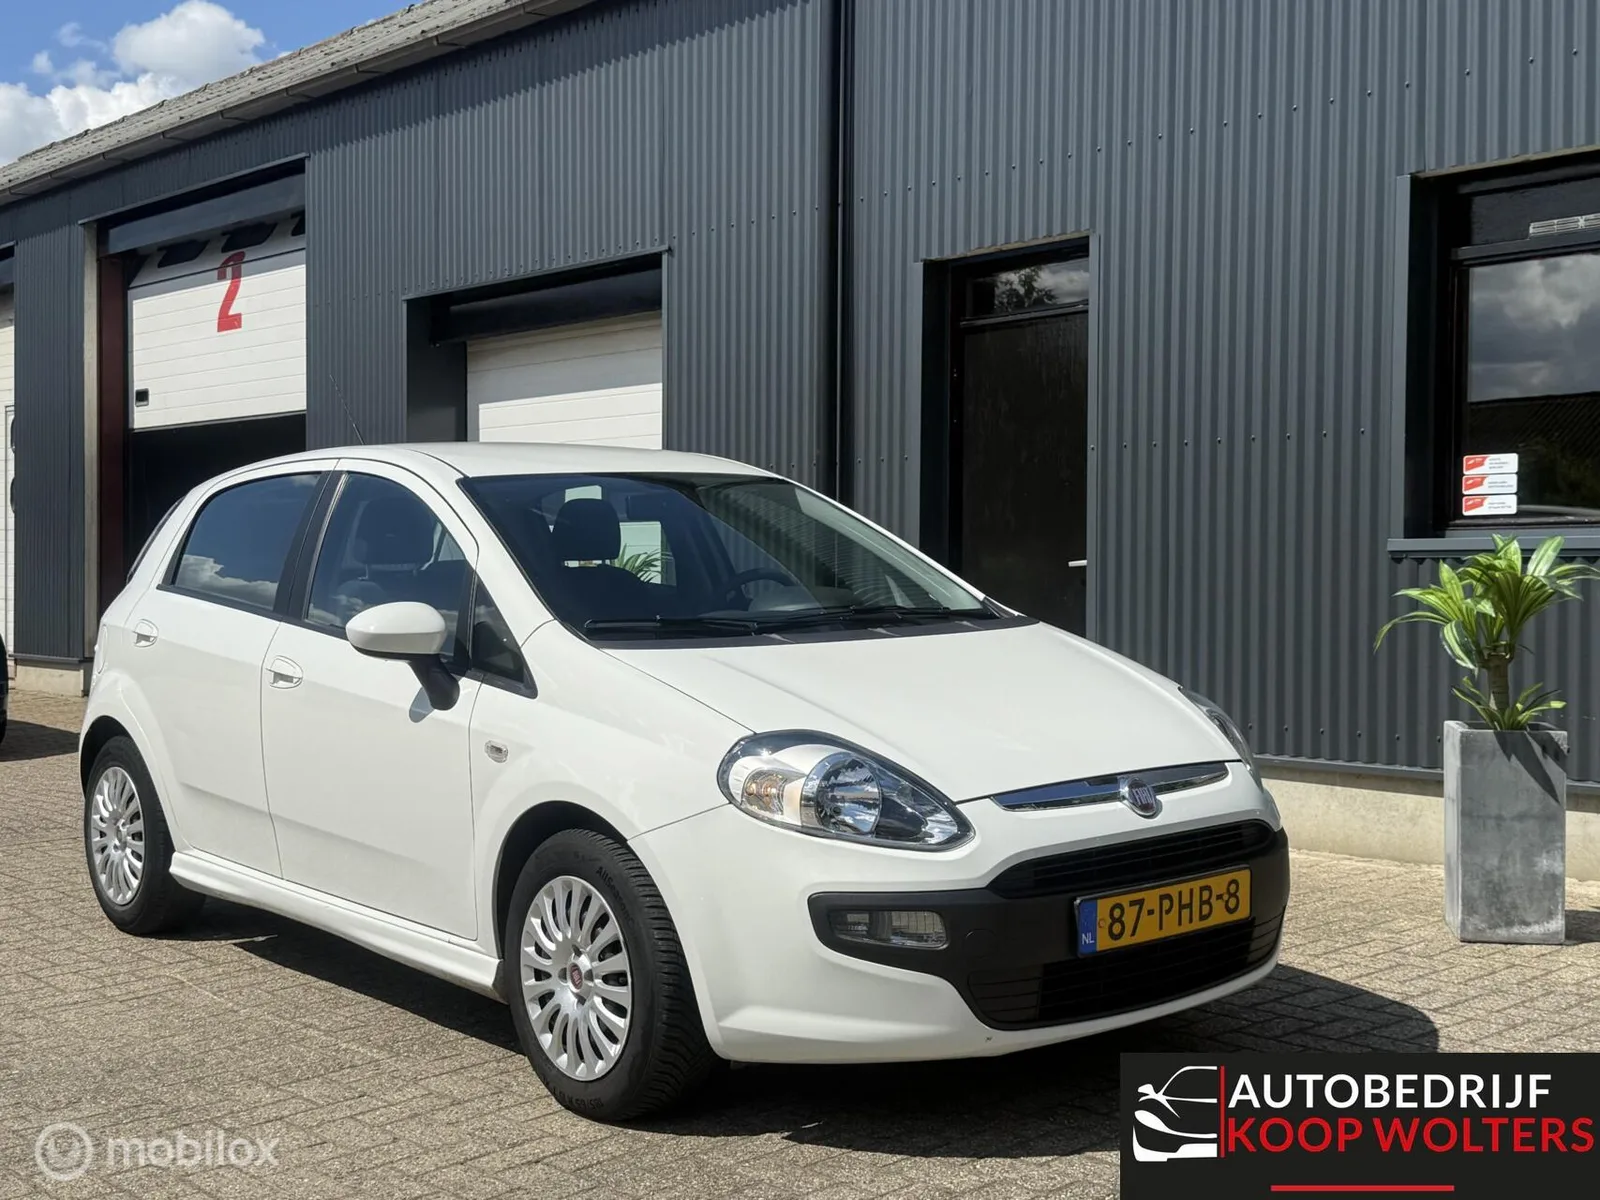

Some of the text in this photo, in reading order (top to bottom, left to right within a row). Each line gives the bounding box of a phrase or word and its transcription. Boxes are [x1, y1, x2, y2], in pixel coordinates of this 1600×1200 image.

[217, 250, 246, 333] 2
[1081, 932, 1095, 945] NL
[1107, 878, 1240, 941] 87-PHB-8
